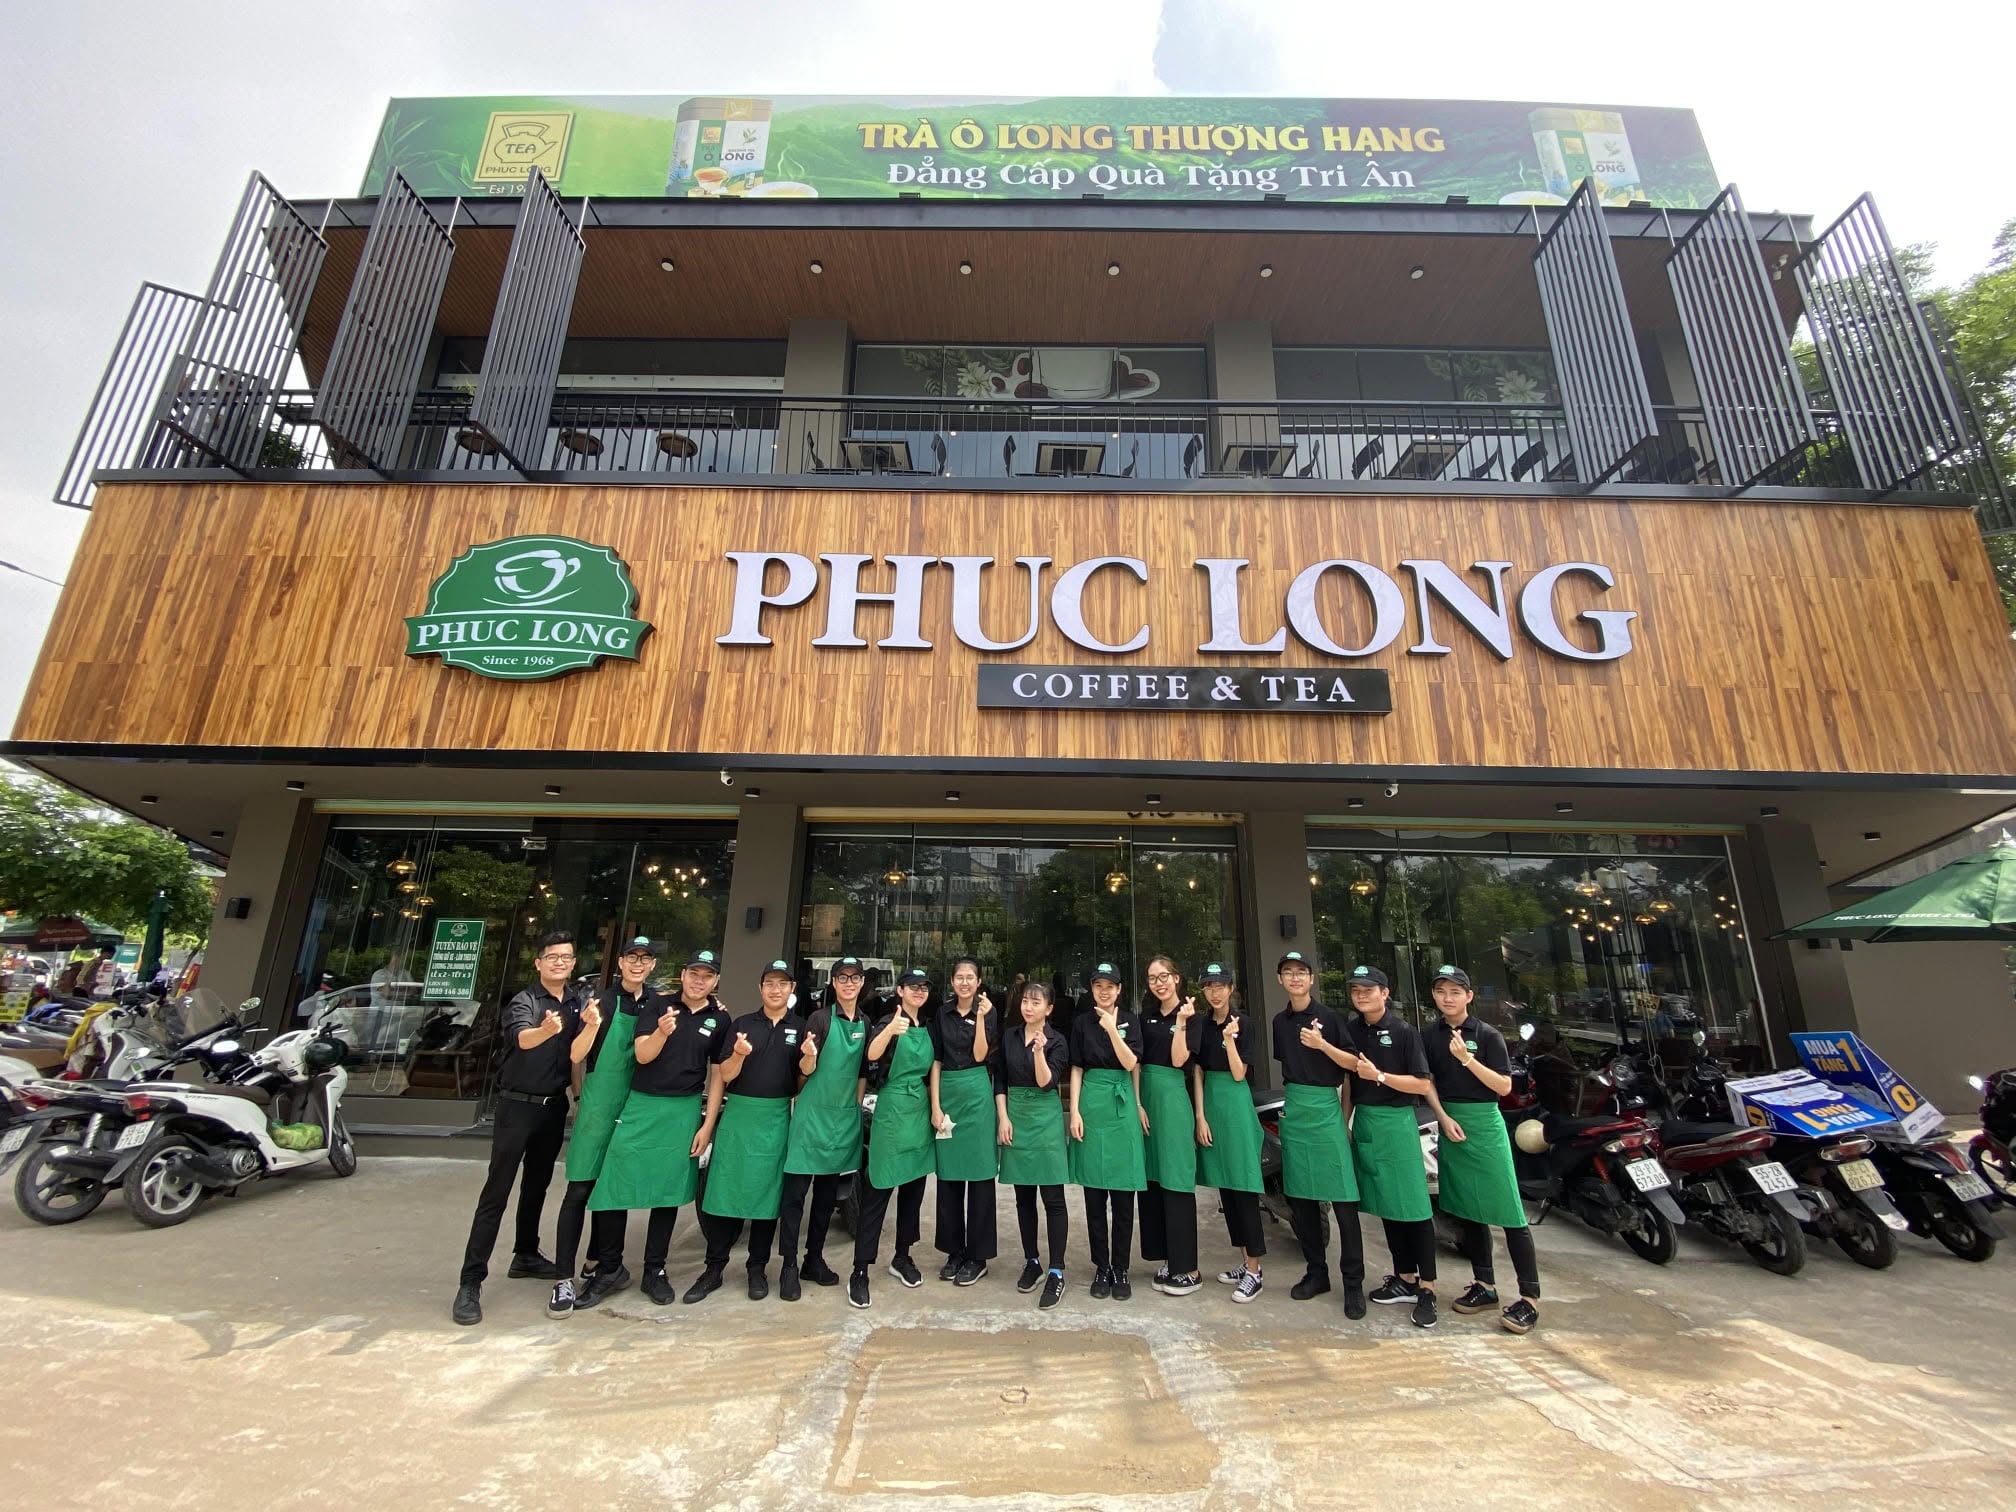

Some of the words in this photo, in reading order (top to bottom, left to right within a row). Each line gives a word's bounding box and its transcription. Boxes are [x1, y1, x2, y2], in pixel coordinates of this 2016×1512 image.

[857, 118, 939, 149] TRÀ
[950, 118, 984, 149] Ô
[996, 124, 1113, 150] LONG
[1125, 124, 1310, 156] THƯỢNG
[1321, 126, 1446, 157] HẠNG
[505, 143, 536, 154] TEA
[719, 152, 755, 161] LONG
[485, 166, 517, 174] PHUC
[888, 156, 987, 189] Đẳng
[1000, 158, 1075, 190] Cấp
[1088, 159, 1166, 191] Quà
[1179, 162, 1280, 192] Tặng
[1290, 165, 1348, 188] Tri
[1361, 161, 1416, 188] Ân
[1591, 164, 1626, 173] LONG
[489, 185, 505, 194] Est
[715, 551, 1150, 654] PHUC
[1197, 557, 1638, 662] LONG
[416, 619, 520, 647] PHUC
[529, 620, 630, 650] LONG
[482, 655, 519, 666] Since
[523, 656, 554, 666] 1968
[1013, 673, 1190, 703] COFFEE
[1210, 674, 1241, 704] &
[1259, 675, 1355, 704] TEA
[1803, 1040, 1840, 1055] MUA
[1835, 1038, 1862, 1072] 1
[1792, 1112, 1831, 1131] 1
[1824, 1110, 1875, 1126] MUA
